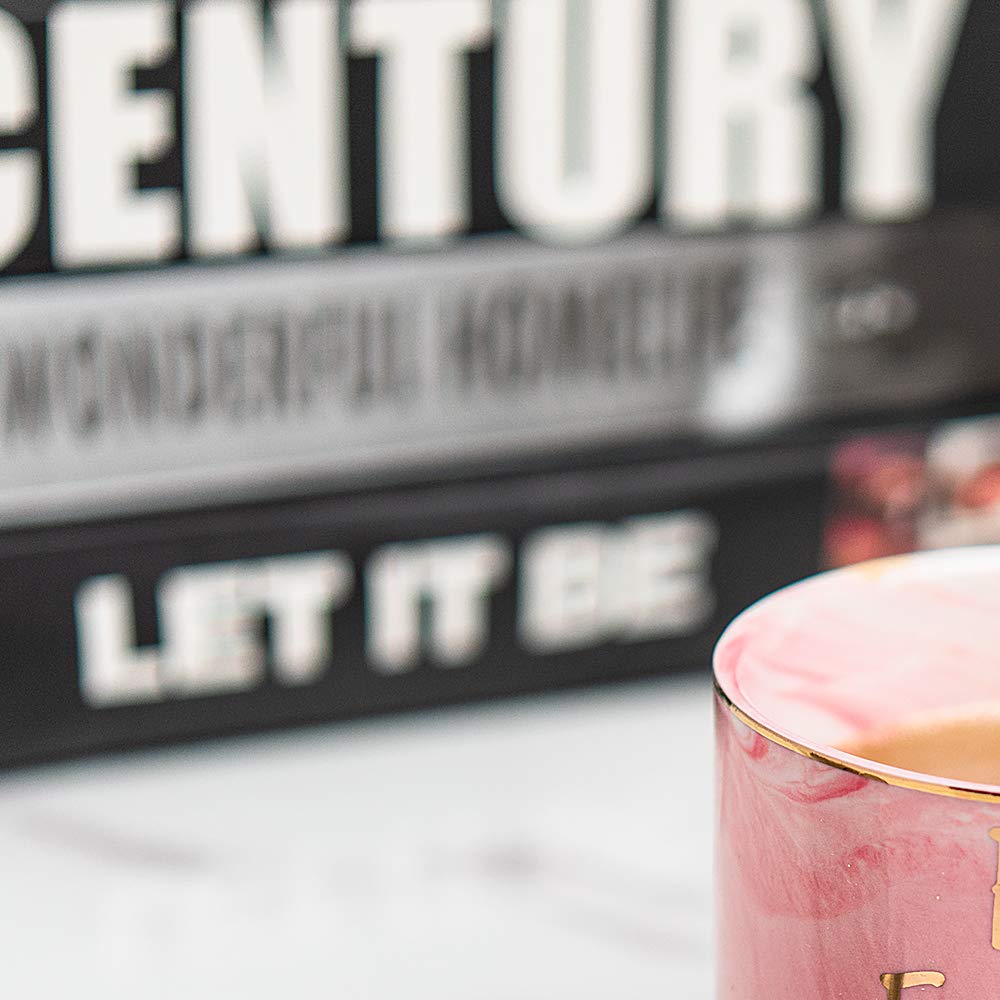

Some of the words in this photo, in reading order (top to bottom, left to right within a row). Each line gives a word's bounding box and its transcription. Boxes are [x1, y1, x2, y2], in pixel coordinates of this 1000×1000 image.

[80, 556, 352, 707] LET
[368, 538, 506, 671] IT
[520, 511, 713, 653] BE
